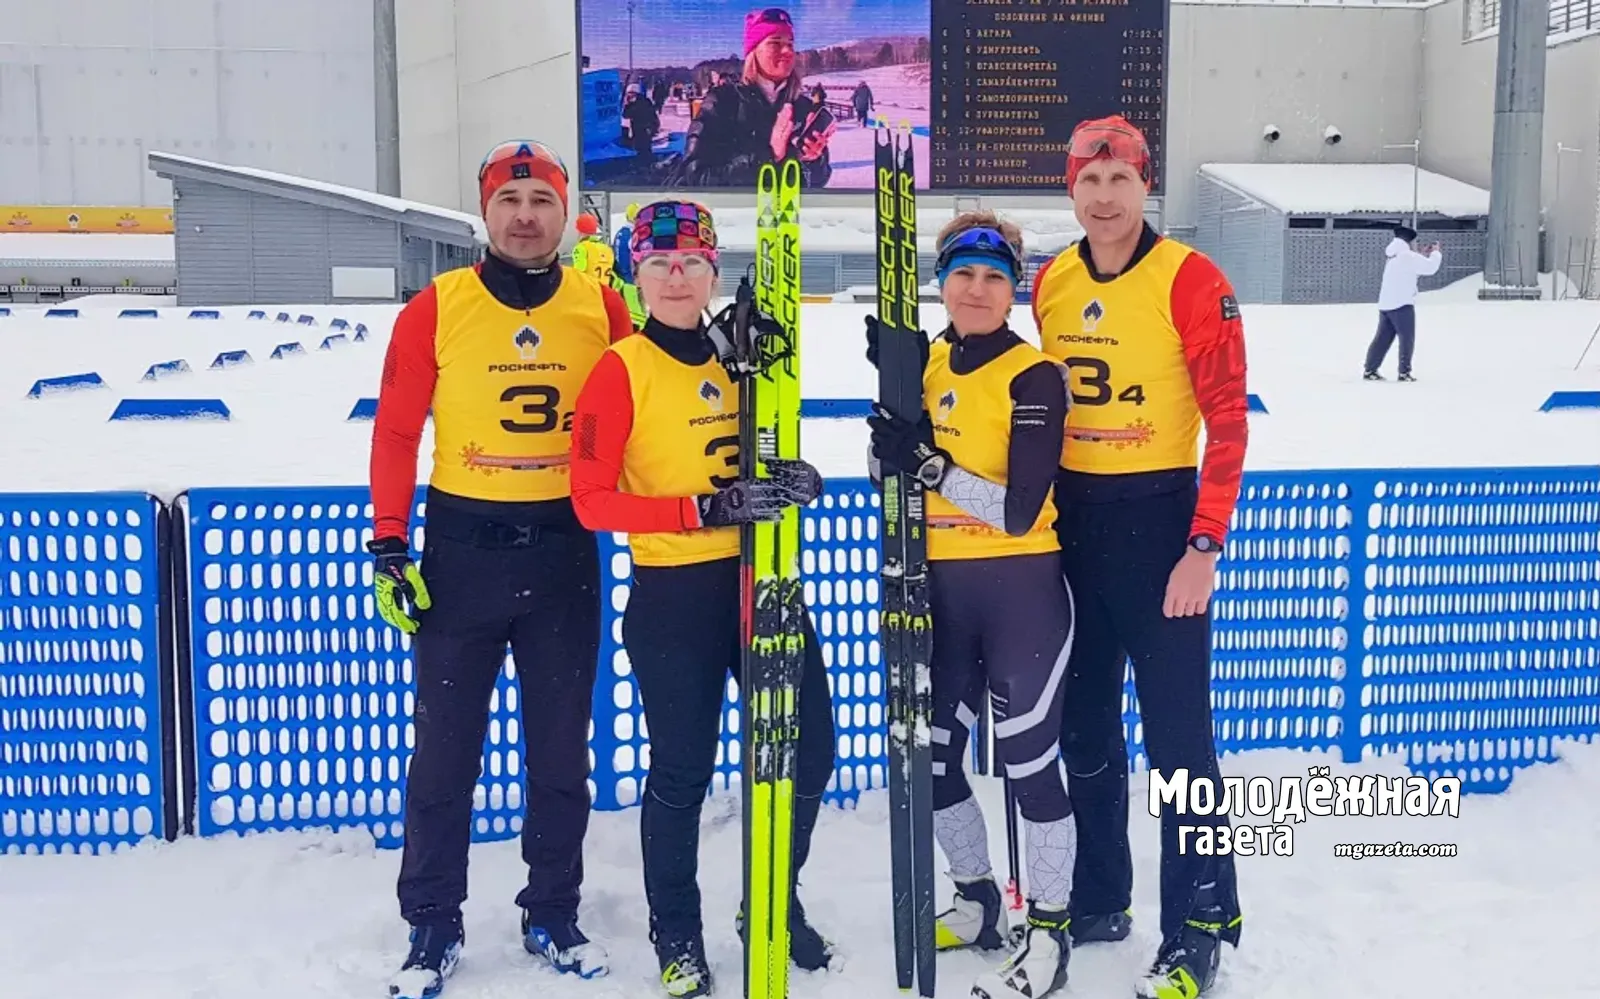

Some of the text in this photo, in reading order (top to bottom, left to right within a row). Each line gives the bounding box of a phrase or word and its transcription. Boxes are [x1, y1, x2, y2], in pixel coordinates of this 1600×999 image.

[879, 167, 896, 328] FISCHER
[900, 172, 918, 332] FISCHER
[781, 233, 797, 379] FISCHER
[1057, 334, 1119, 346] РОСНЕФТЬ
[488, 363, 567, 372] РОСНЕФТЬ
[500, 385, 560, 433] 3
[689, 411, 740, 427] РОСНЕФ
